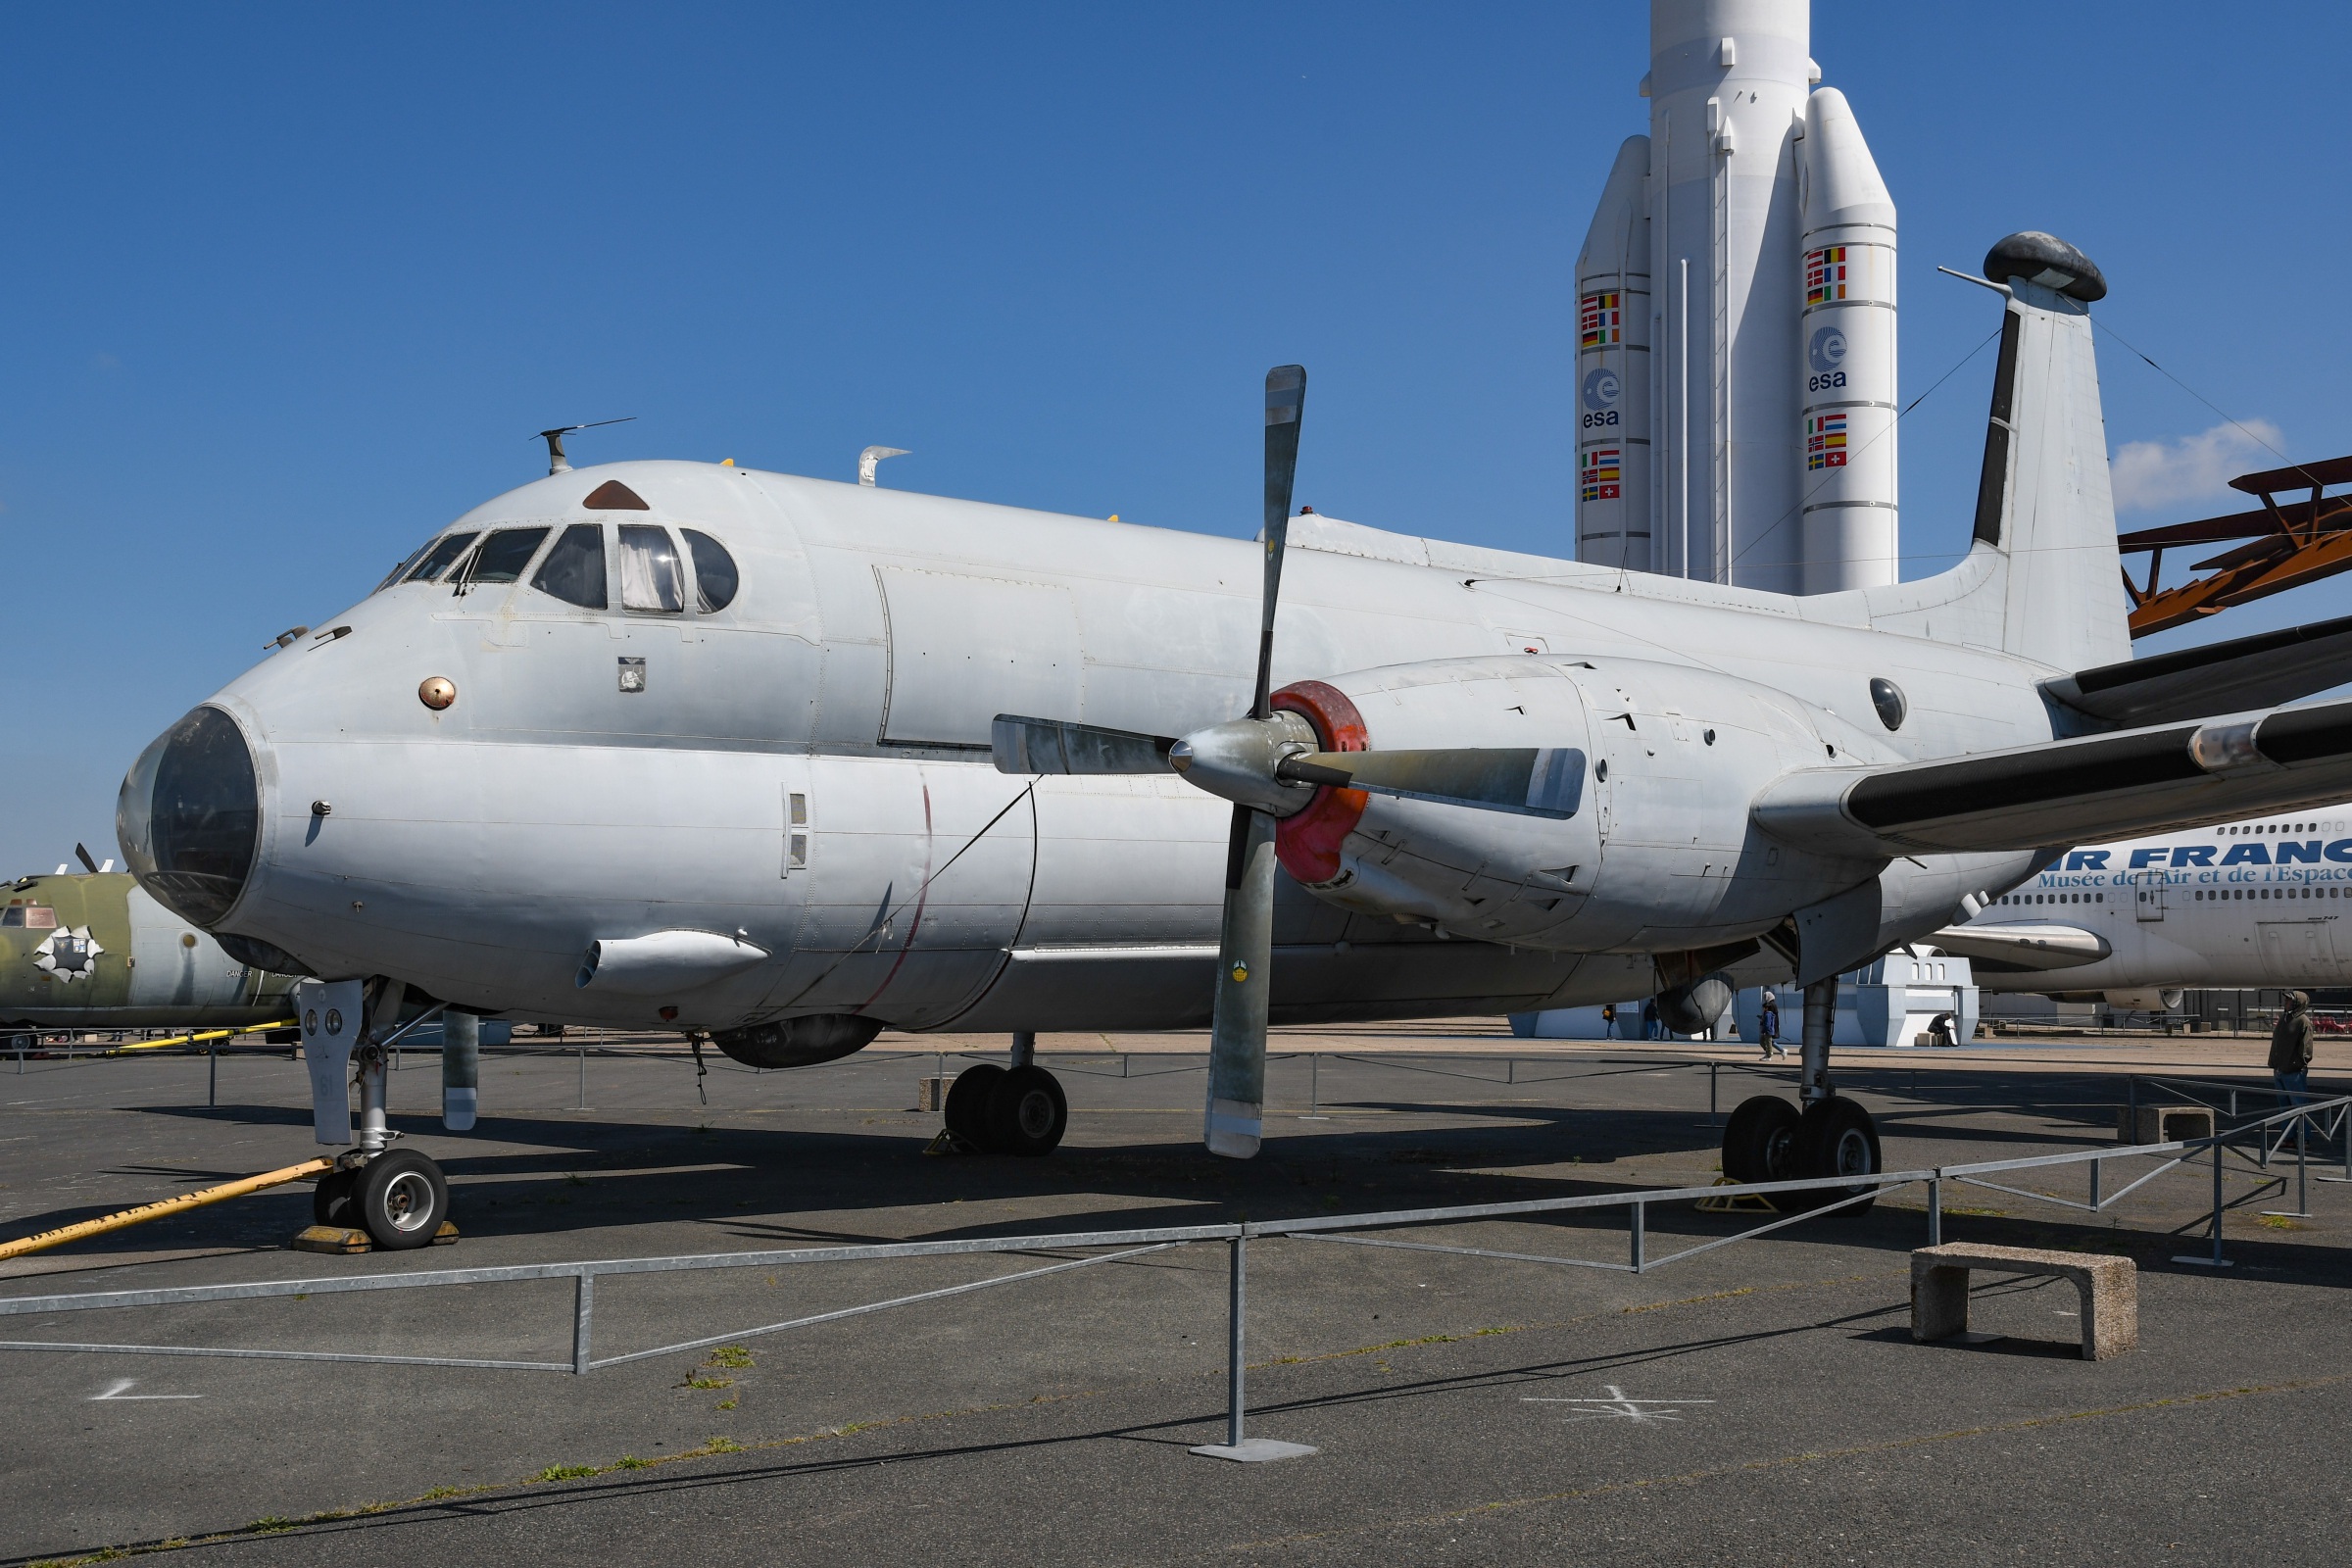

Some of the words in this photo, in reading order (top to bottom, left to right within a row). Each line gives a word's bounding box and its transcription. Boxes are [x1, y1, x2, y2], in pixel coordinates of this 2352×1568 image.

[1809, 371, 1847, 393] esa
[1583, 411, 1619, 429] esa
[2036, 871, 2106, 888] Musée
[2112, 870, 2138, 886] de
[2145, 868, 2192, 885] l'Air
[2198, 868, 2221, 884] et
[2228, 866, 2257, 883] de
